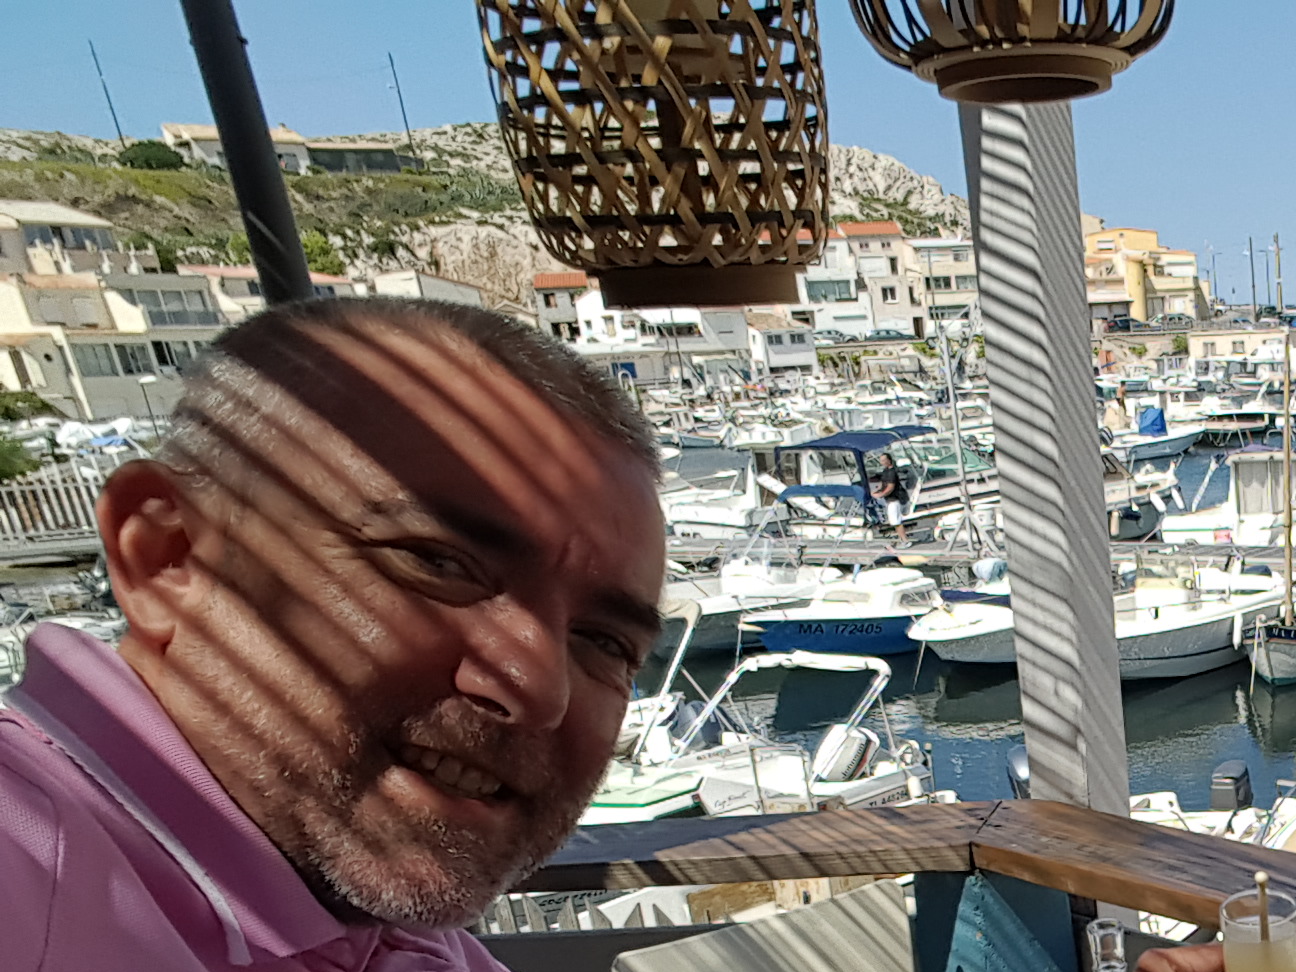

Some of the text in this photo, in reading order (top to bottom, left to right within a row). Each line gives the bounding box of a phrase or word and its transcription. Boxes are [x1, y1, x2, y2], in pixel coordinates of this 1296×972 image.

[798, 622, 883, 635] MA 172405
[841, 742, 866, 780] Johnson
